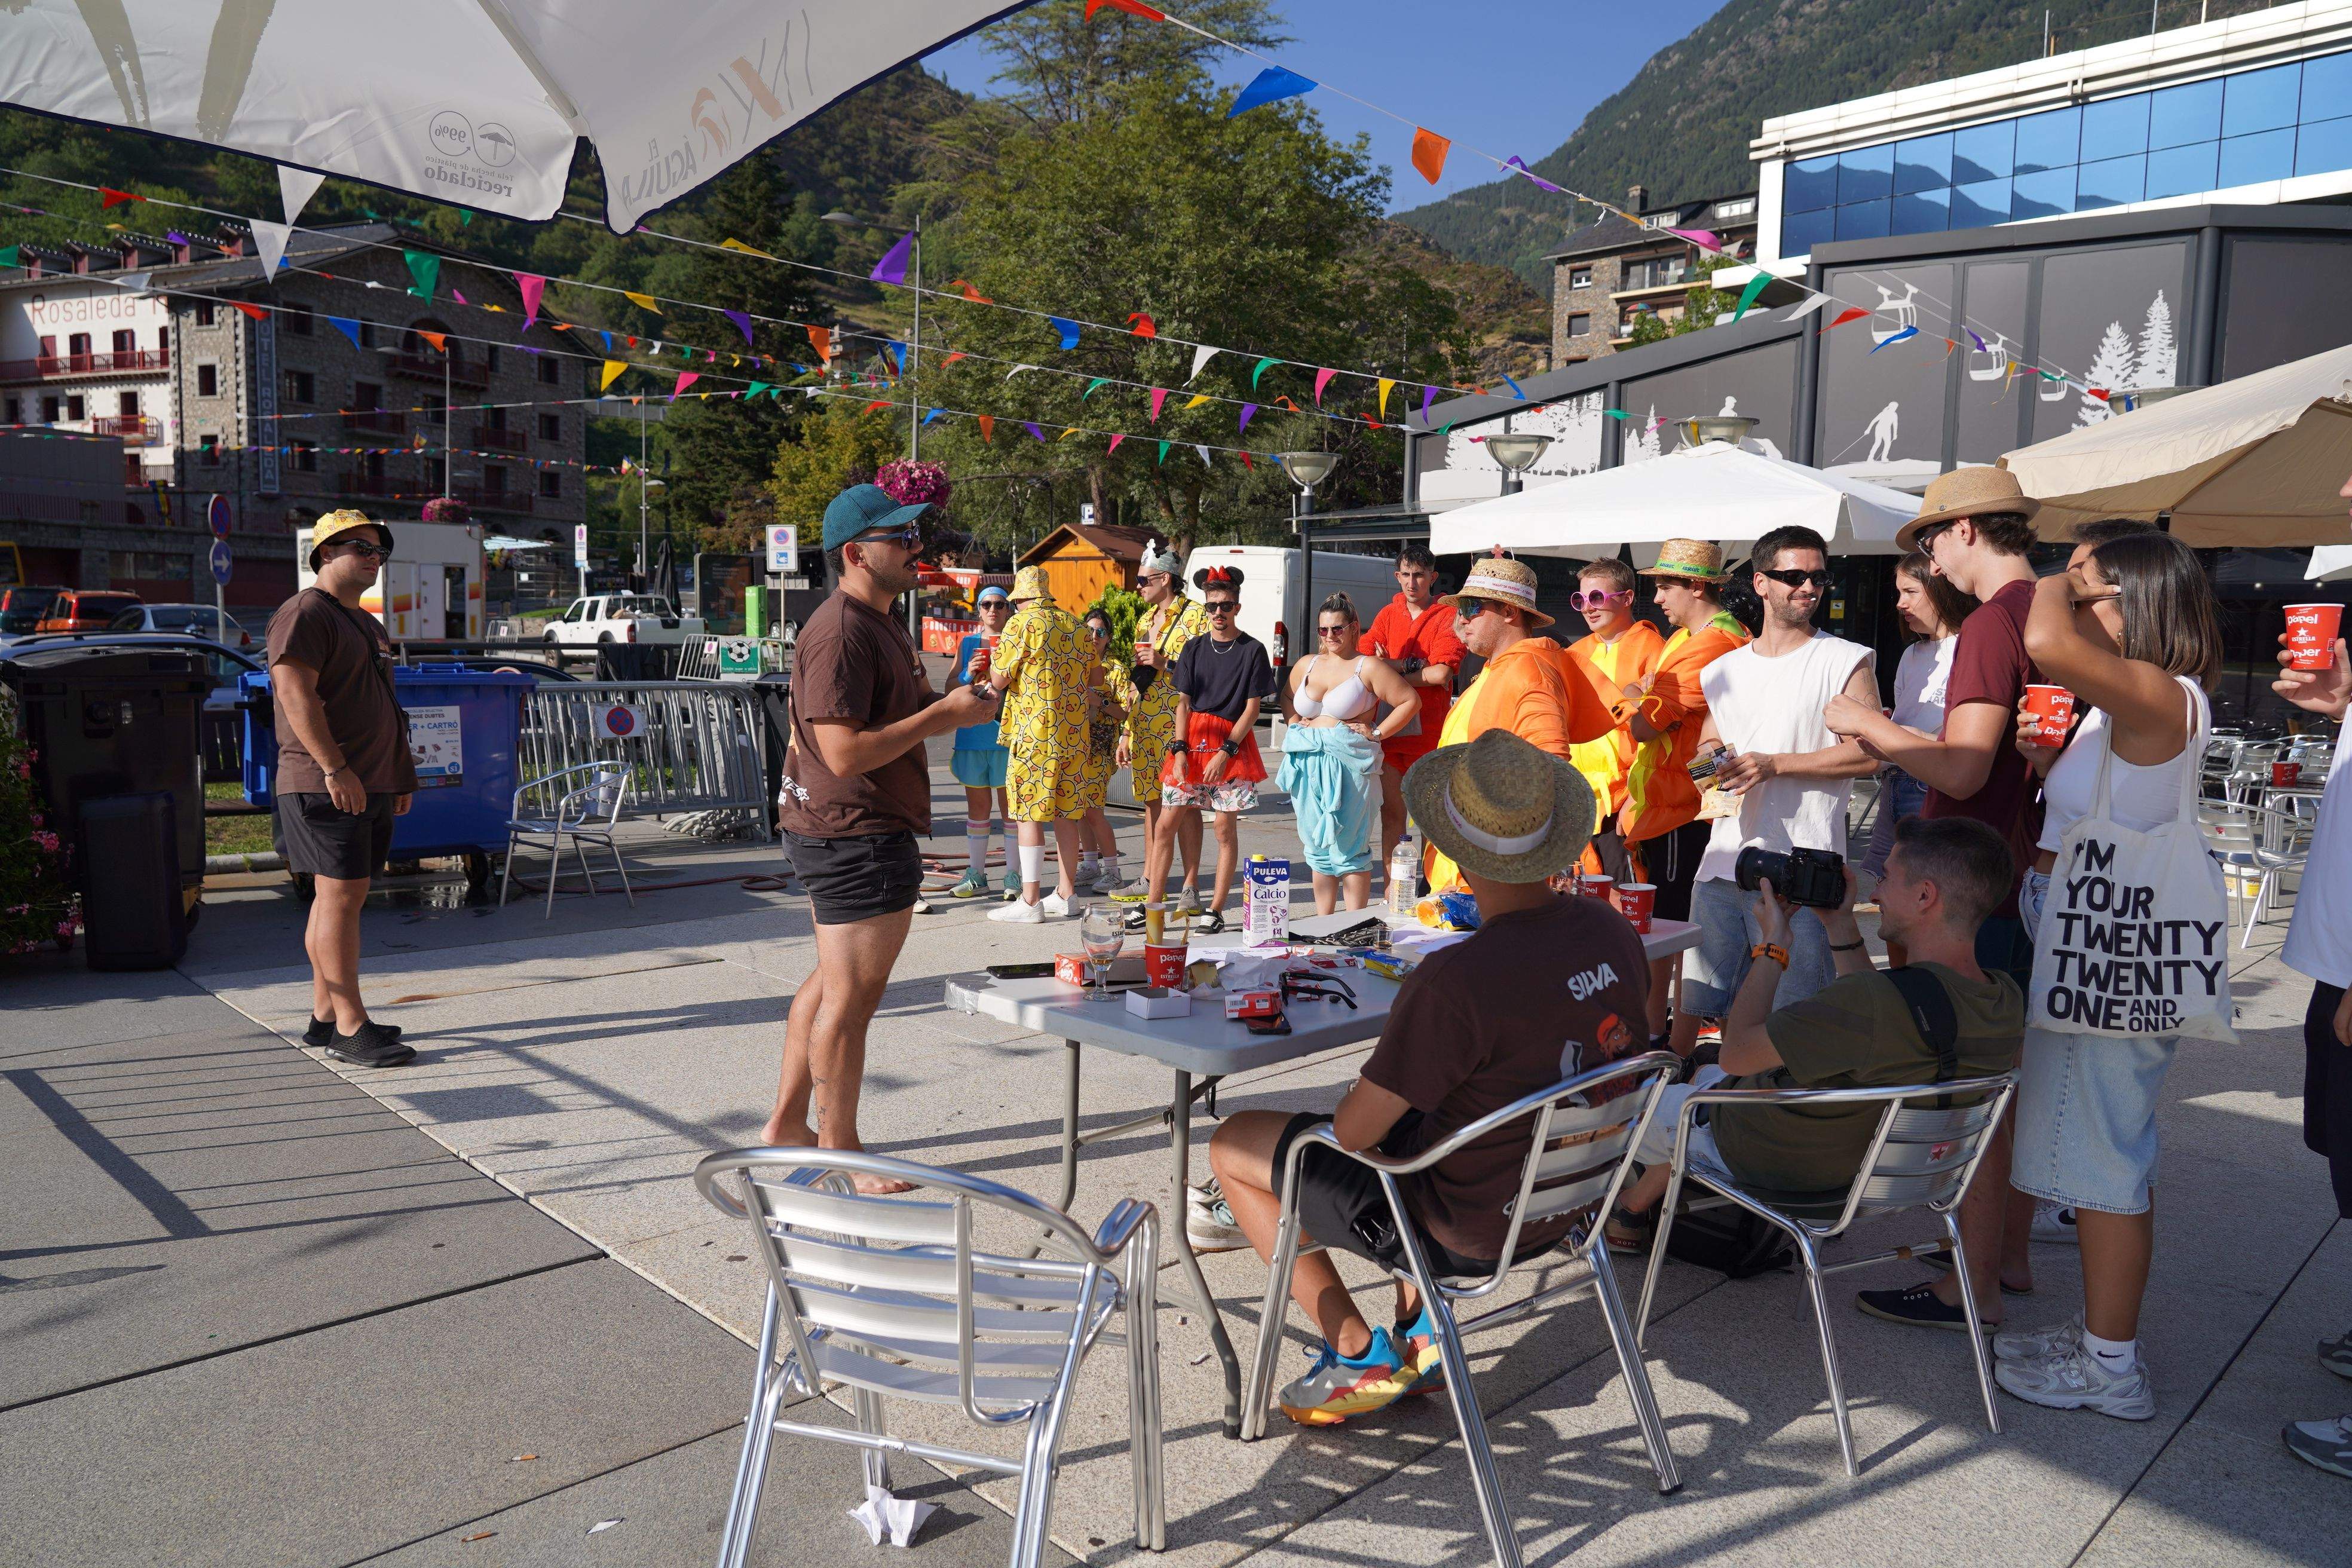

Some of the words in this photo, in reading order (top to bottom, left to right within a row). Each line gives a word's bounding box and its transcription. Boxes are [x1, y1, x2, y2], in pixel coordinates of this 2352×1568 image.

[32, 287, 136, 325] Rosaleda
[260, 321, 271, 382] OTEL
[2287, 614, 2319, 627] papel
[427, 719, 458, 729] CARTRÓ
[1253, 867, 1288, 876] PULEVA
[1254, 888, 1287, 900] Calcio
[2066, 875, 2155, 920] YOUR
[2056, 911, 2225, 957] TWENTY
[1567, 962, 1619, 1002] SILVA
[2051, 948, 2224, 996] TWENTY
[2046, 985, 2127, 1031] ONE
[2129, 998, 2178, 1016] AND
[2128, 1016, 2186, 1033] ONLY
